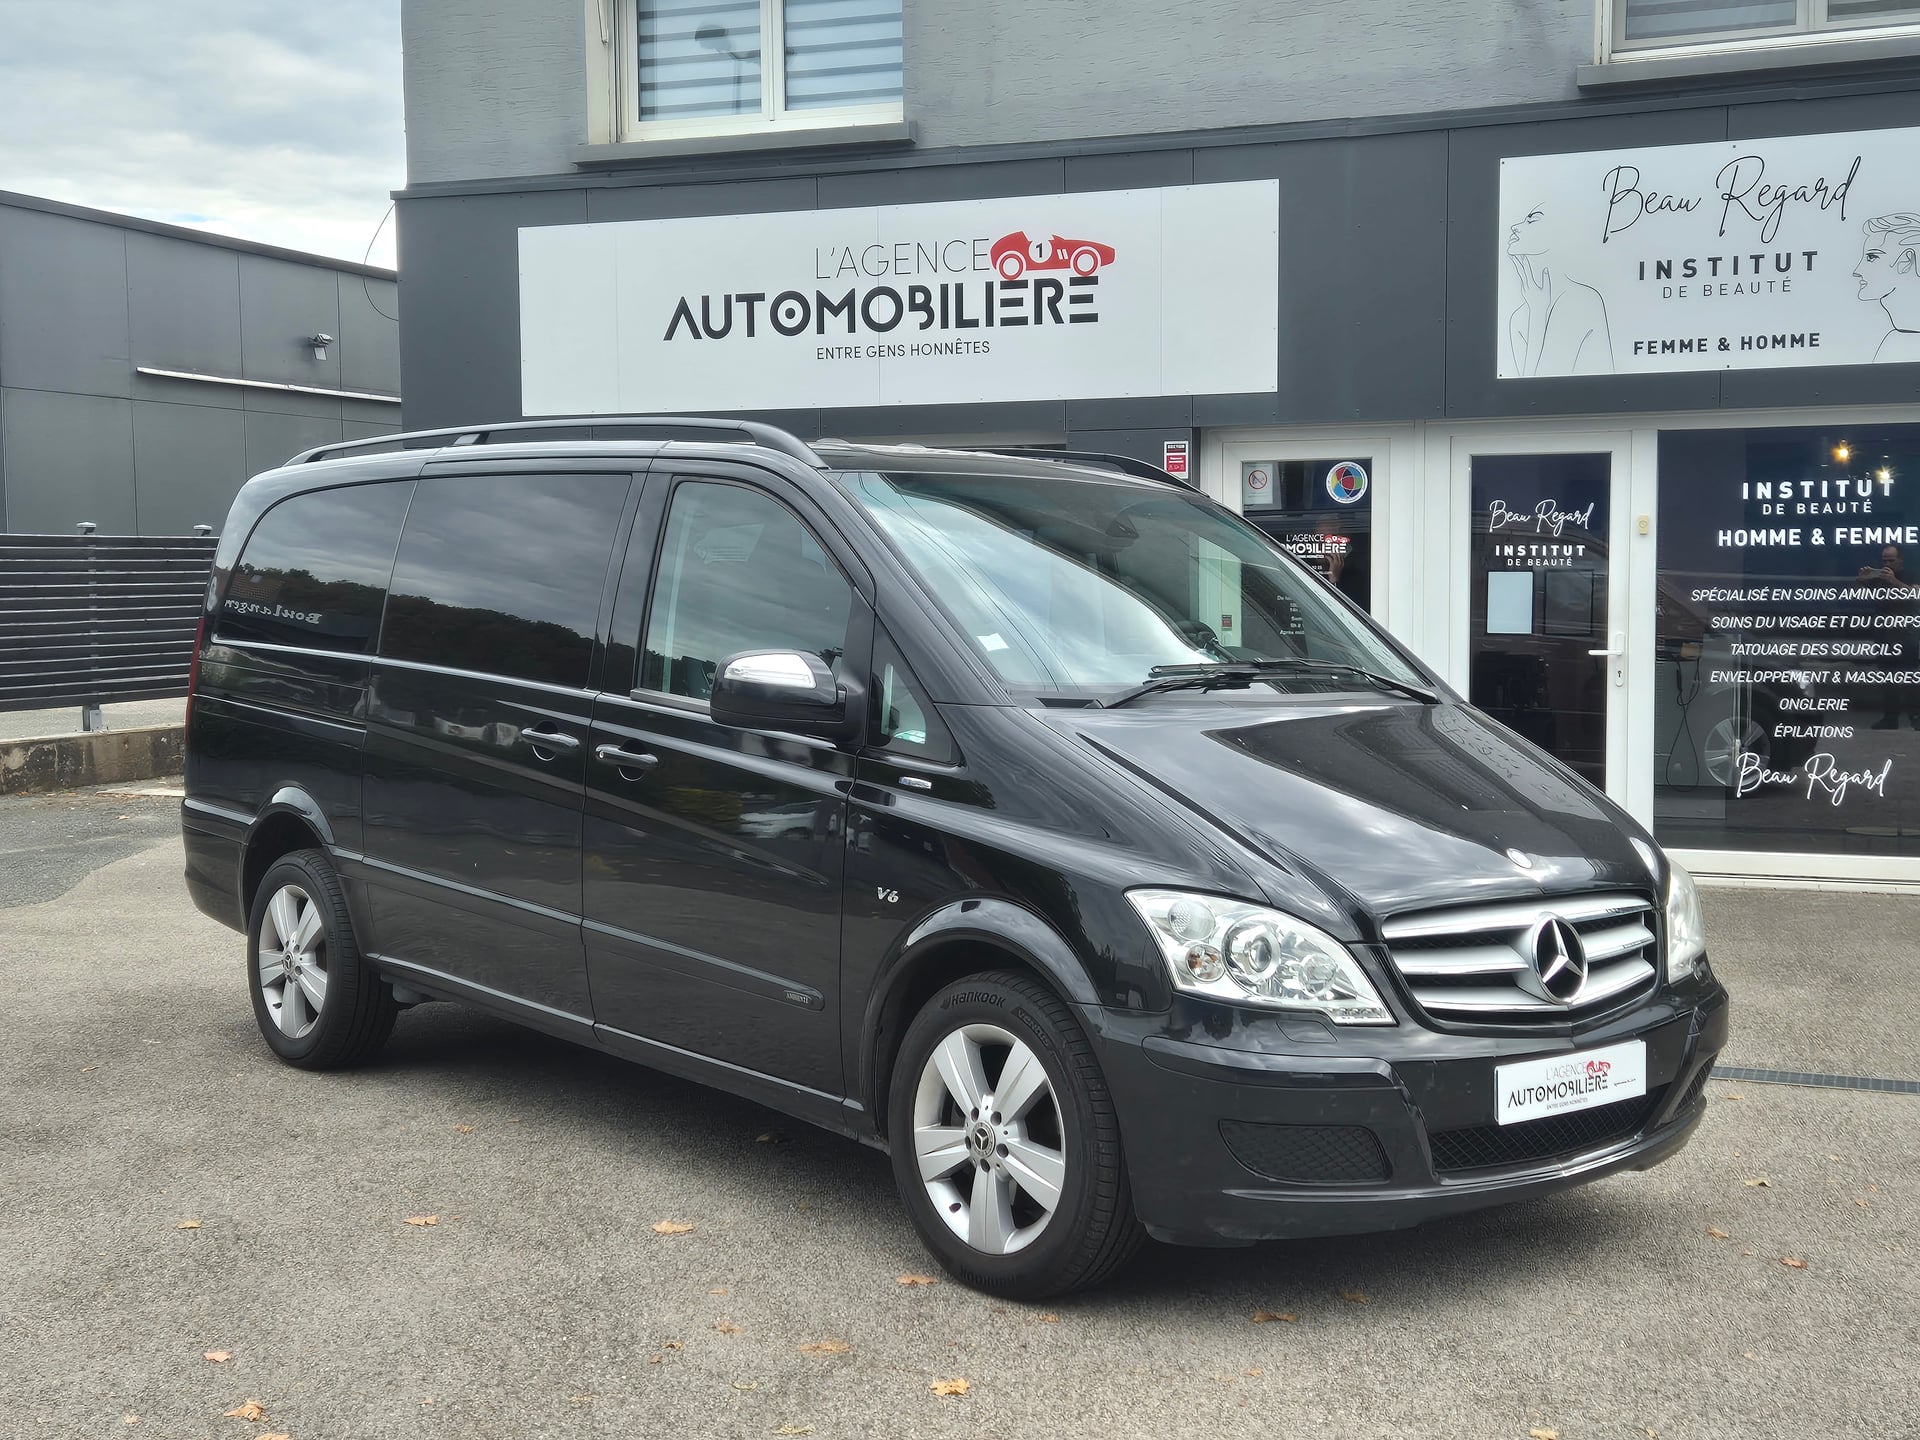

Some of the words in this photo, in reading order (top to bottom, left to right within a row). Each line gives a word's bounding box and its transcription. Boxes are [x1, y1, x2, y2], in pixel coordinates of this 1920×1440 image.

[1603, 166, 1701, 243] Beau
[1716, 156, 1862, 243] Regard
[814, 238, 989, 280] L'AGENCE
[1639, 251, 1818, 281] INSTITUT
[1663, 286, 1687, 298] DE
[1704, 276, 1792, 296] BEAUTÉ
[817, 346, 861, 359] ENTRE
[867, 345, 905, 357] GENS
[911, 338, 989, 355] HONNÊTES
[1634, 338, 1707, 355] FEMME
[1718, 338, 1730, 351] &
[1741, 333, 1819, 350] HOMME
[1742, 479, 1894, 499] INSTITUT
[1763, 504, 1784, 514] DE
[1797, 499, 1872, 514] BEAUTÉ
[1489, 500, 1530, 532] Beau
[1535, 499, 1594, 537] Regard
[1286, 534, 1324, 542] L'AGENCE
[1719, 529, 1801, 546] HOMME
[1811, 528, 1825, 545] &
[1836, 527, 1918, 544] FEMME
[1496, 545, 1586, 556] INSTITUT
[1528, 557, 1573, 567] BEAUTÉ
[1691, 587, 1769, 601] SPÉCIALISÉ
[1772, 589, 1791, 600] EN
[1794, 588, 1837, 600] SOINS
[1712, 617, 1753, 628] SOINS
[1755, 617, 1775, 628] DU
[1779, 616, 1827, 628] VISAGE
[1830, 616, 1848, 627] ET
[1850, 616, 1871, 627] DU
[1874, 616, 1920, 627] CORPS
[1731, 644, 1798, 655] TATOUAGE
[1800, 643, 1829, 656] DES
[1830, 643, 1902, 656] SOURCILS
[1710, 670, 1830, 684] ENVELOPPEMENT
[1831, 670, 1841, 684] &
[1845, 671, 1920, 684] MASSAGES
[1780, 698, 1849, 710] ONGLERIE
[1774, 723, 1853, 738] ÉPILATIONS
[1736, 752, 1798, 798] Beau
[1804, 753, 1893, 806] Regard
[878, 887, 898, 902] V6
[1546, 1061, 1587, 1080] L'AGENCE
